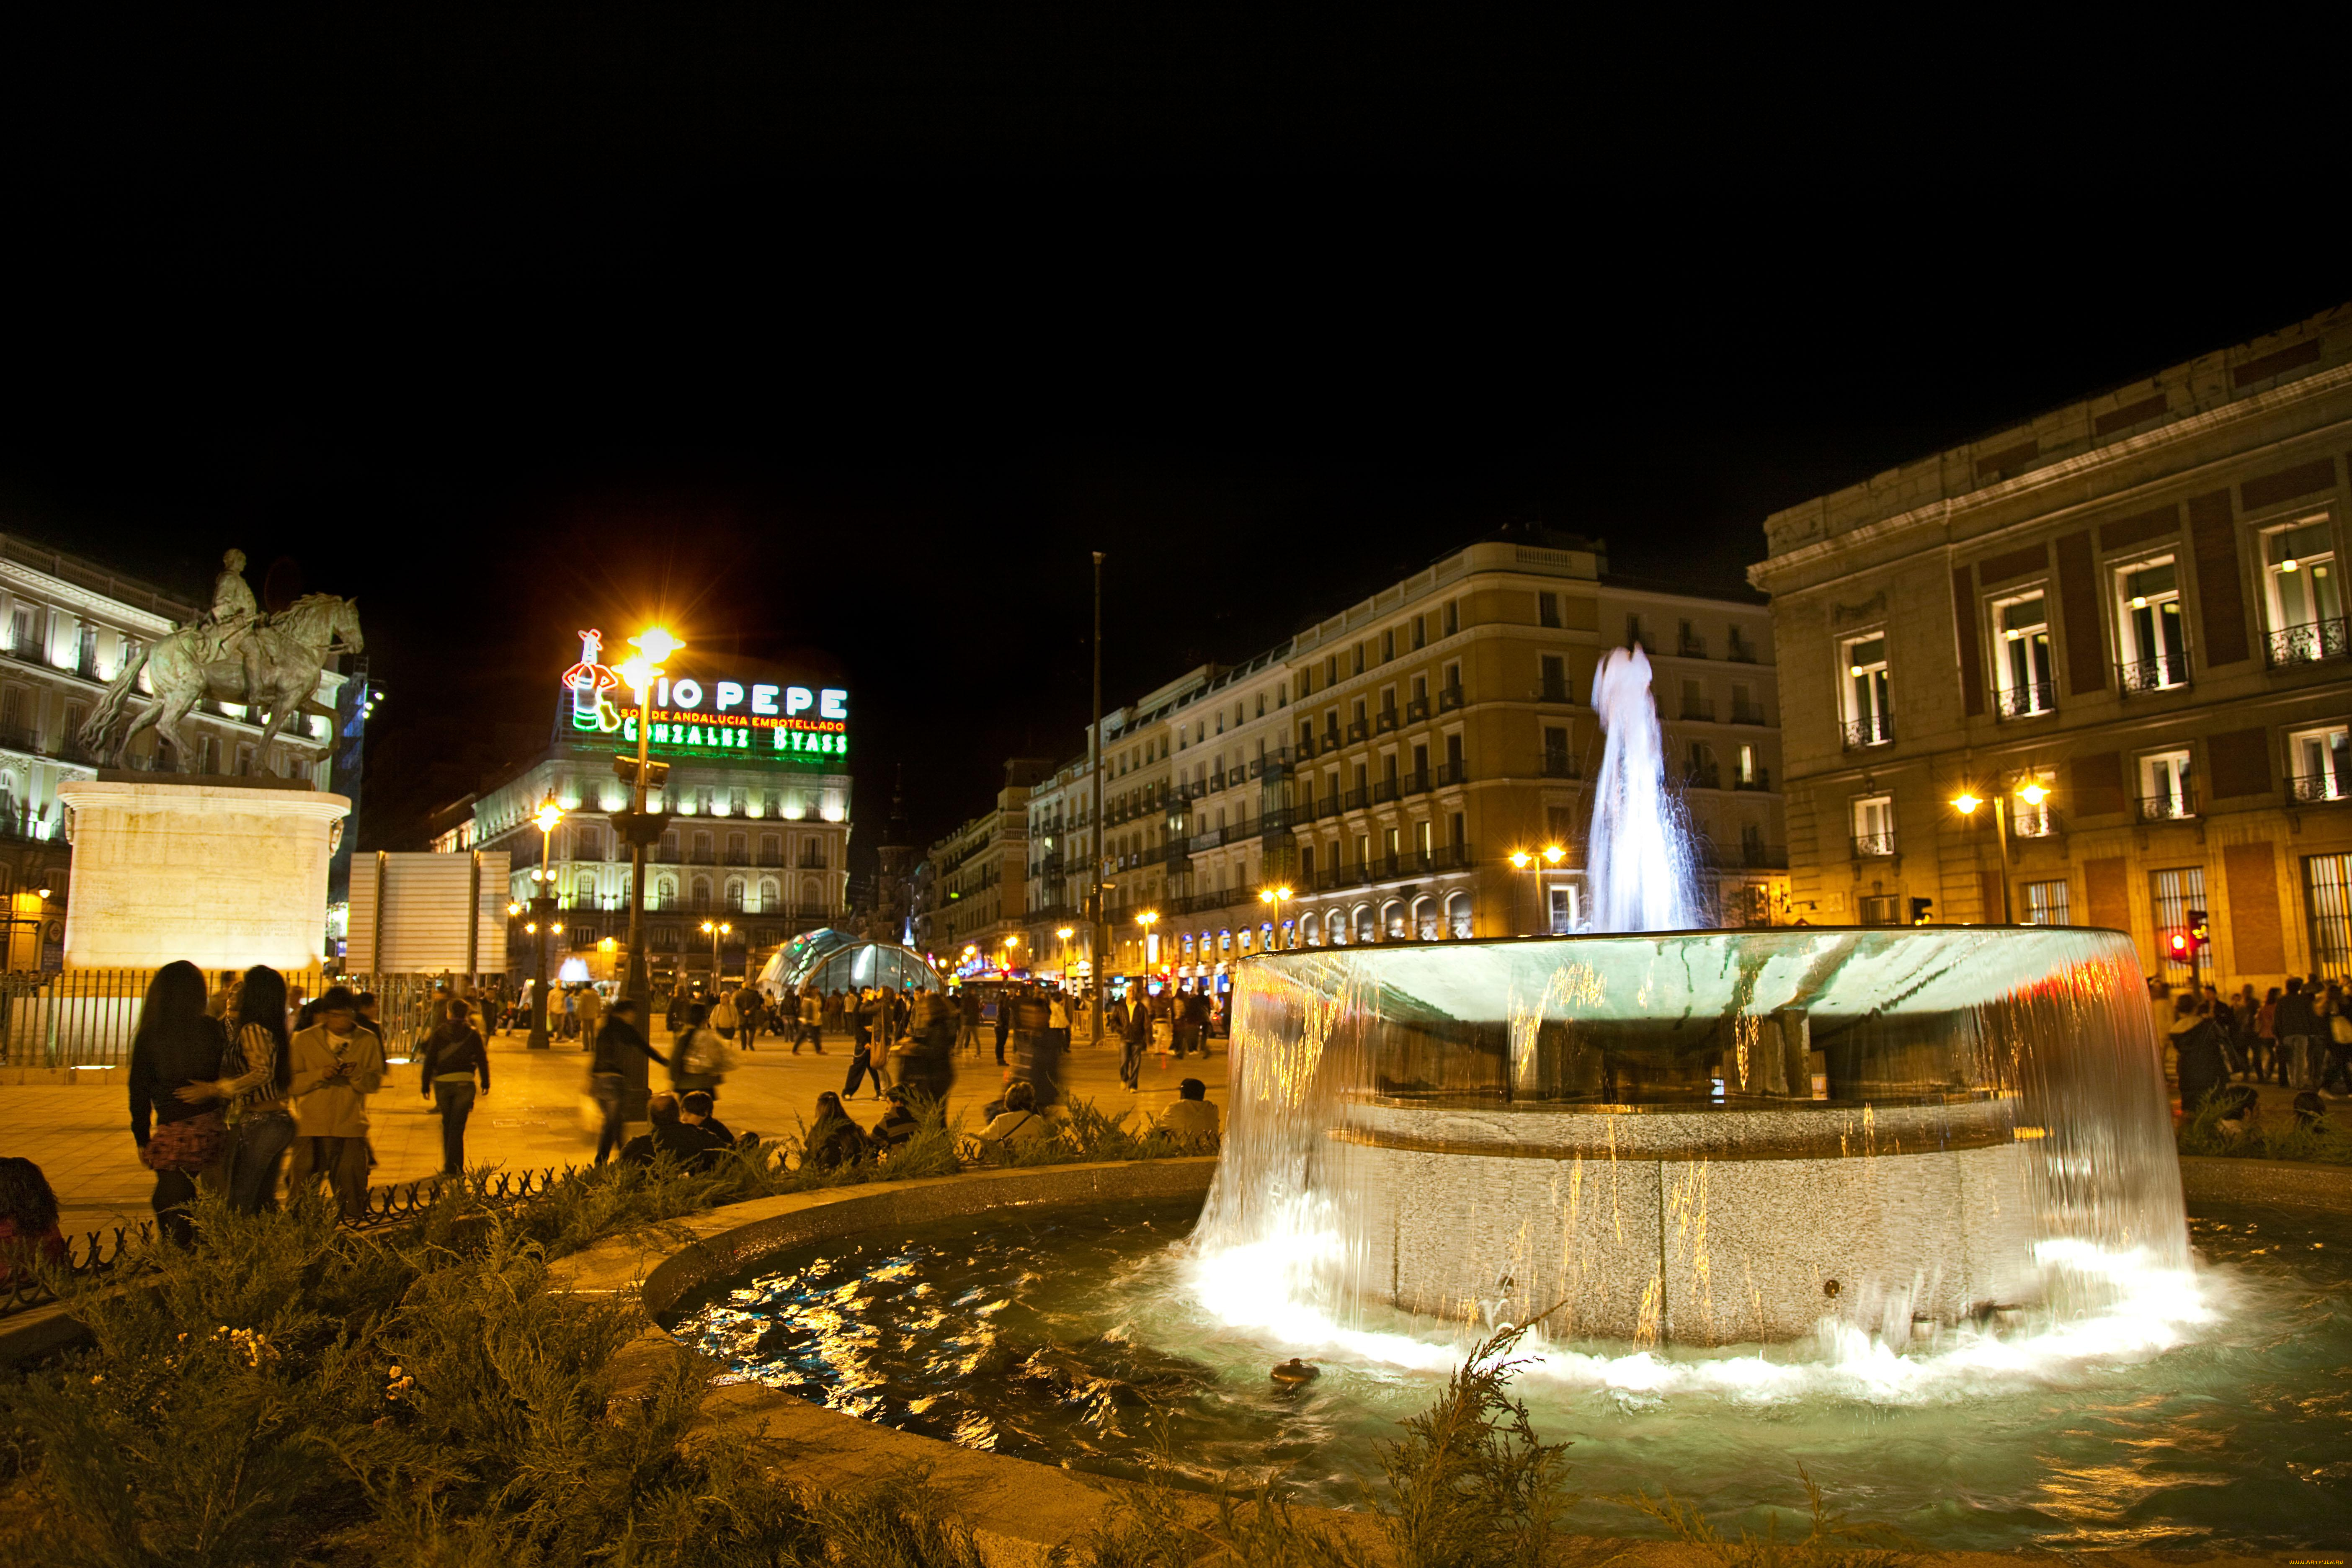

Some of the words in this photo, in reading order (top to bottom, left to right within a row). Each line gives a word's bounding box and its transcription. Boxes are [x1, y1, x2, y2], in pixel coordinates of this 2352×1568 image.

[717, 681, 848, 719] PEPE
[620, 708, 640, 719] SO
[651, 710, 669, 721] DE
[673, 712, 749, 727] ANDALUCIA
[752, 717, 845, 732] EMBOTELLADO
[774, 726, 848, 754] BYASS
